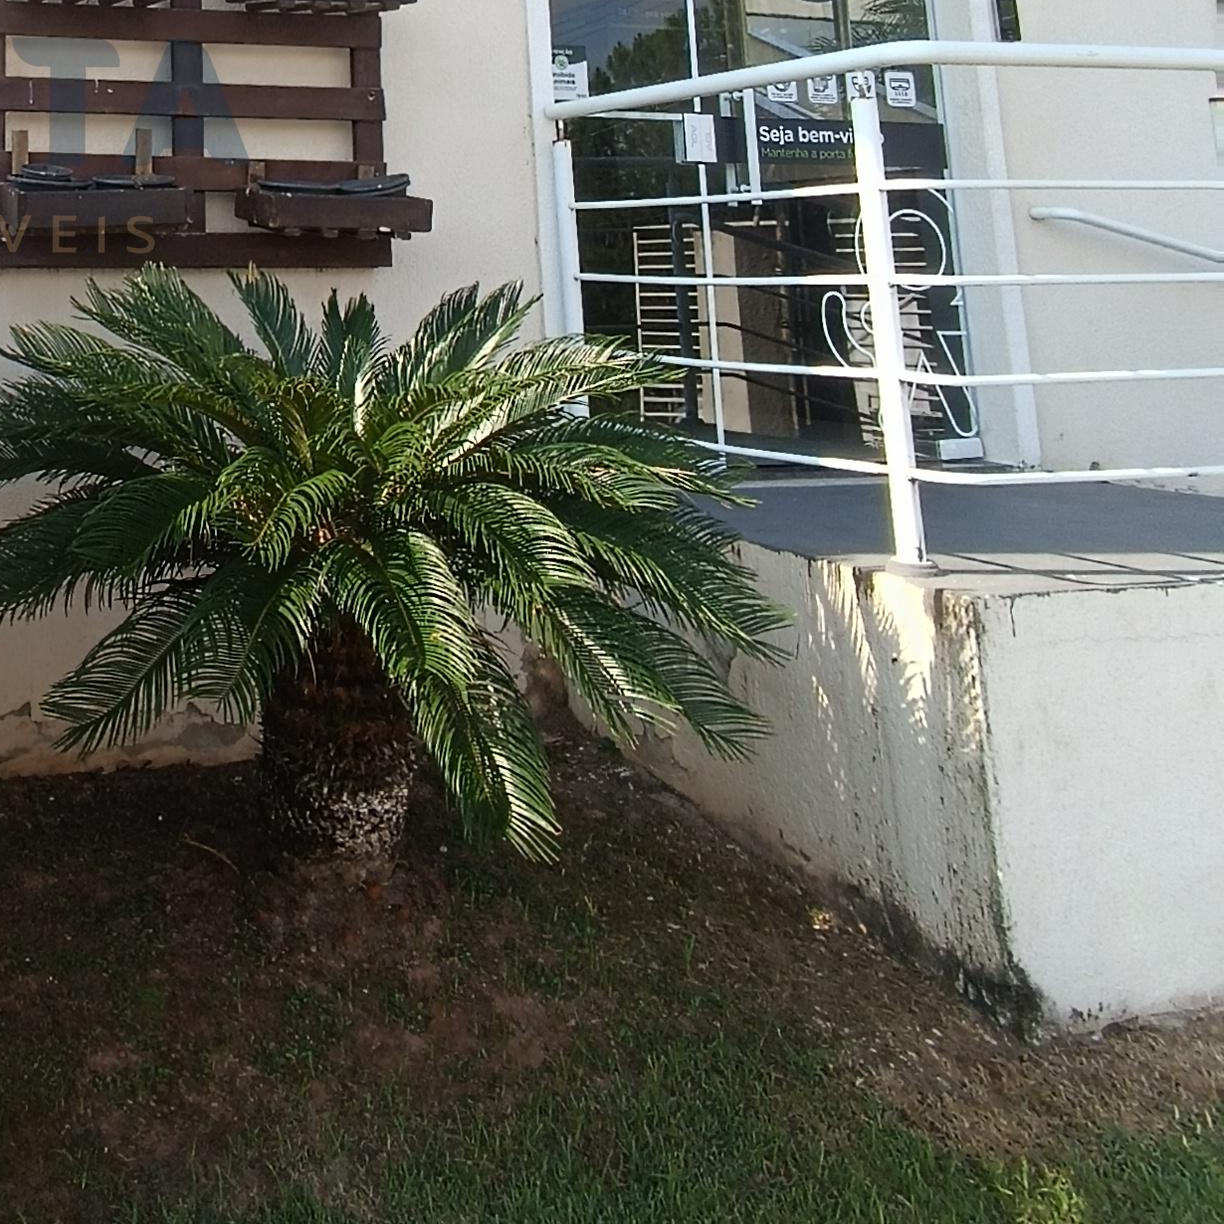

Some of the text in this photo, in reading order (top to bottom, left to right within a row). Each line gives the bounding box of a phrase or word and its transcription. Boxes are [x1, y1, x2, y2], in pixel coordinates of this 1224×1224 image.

[759, 125, 854, 145] Seja bem-vi
[761, 147, 809, 158] Mantenha
[811, 149, 818, 158] a
[820, 149, 846, 160] porta
